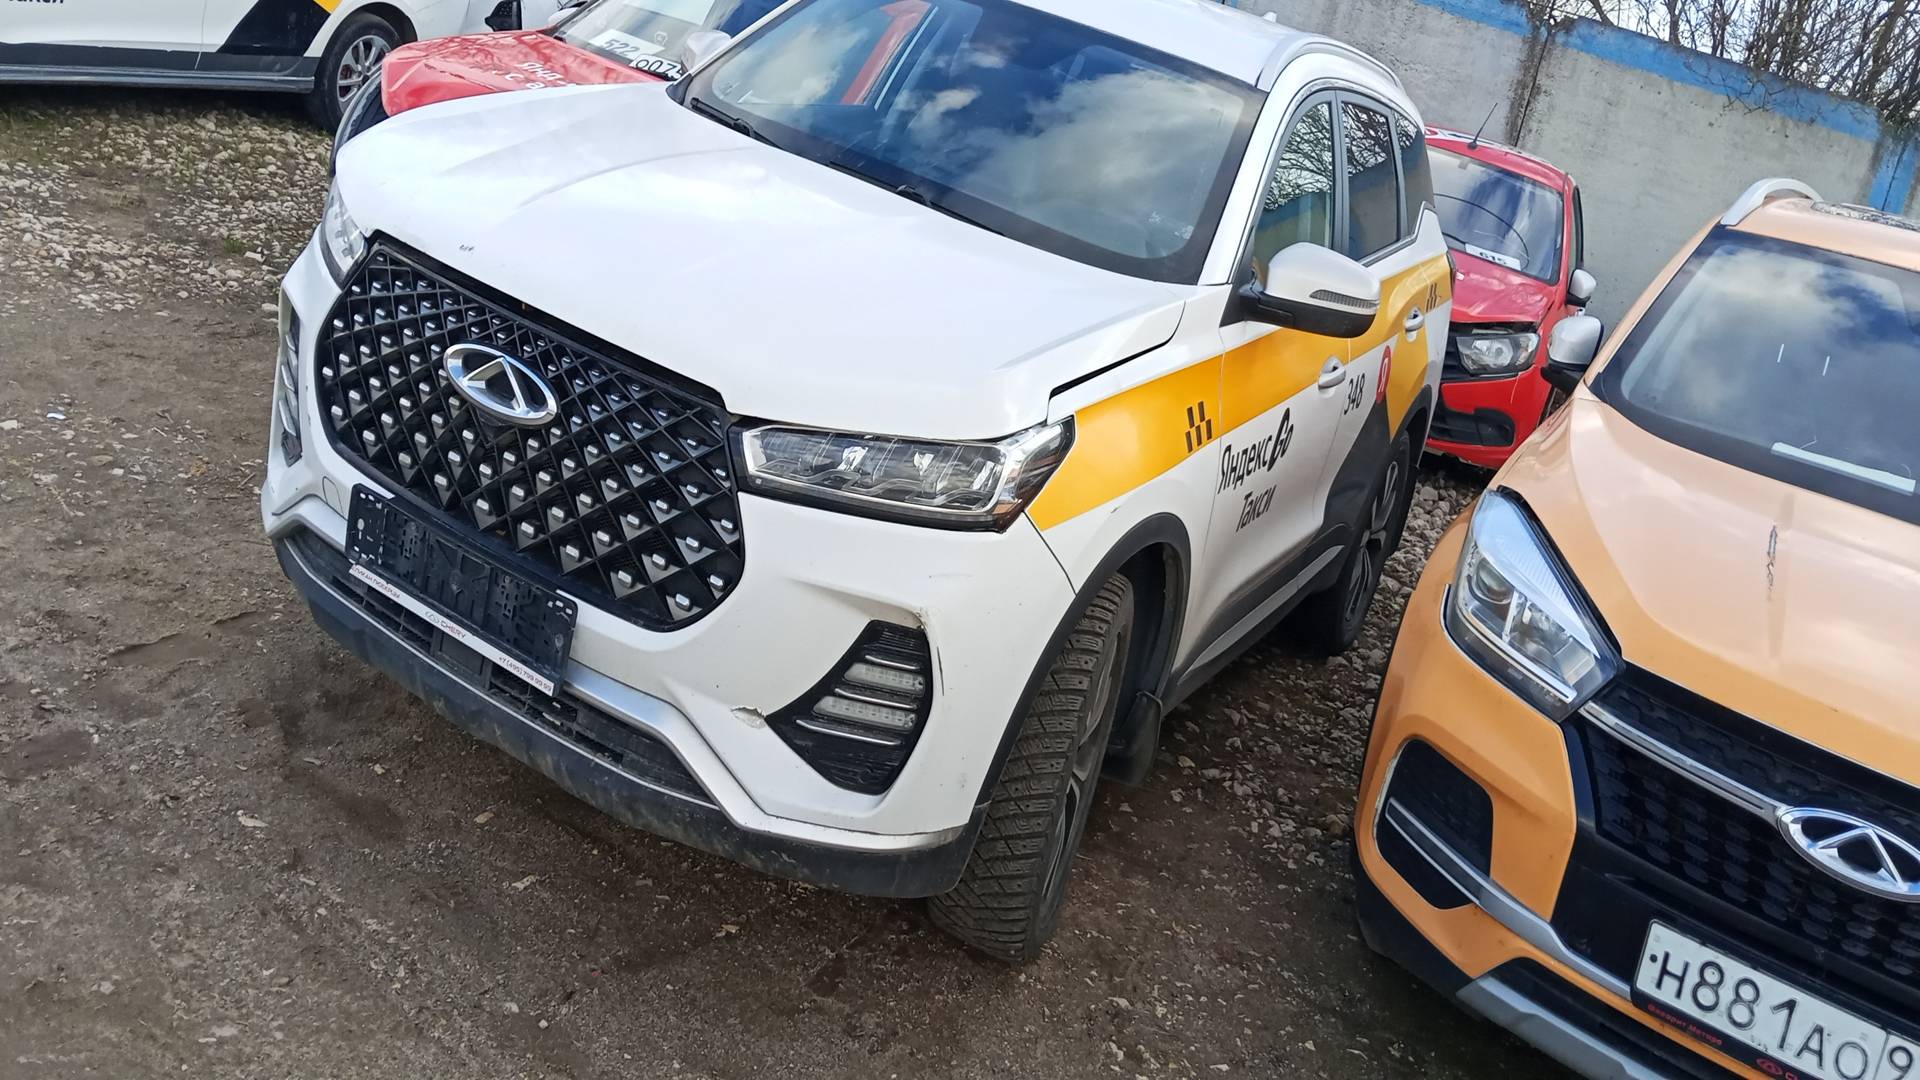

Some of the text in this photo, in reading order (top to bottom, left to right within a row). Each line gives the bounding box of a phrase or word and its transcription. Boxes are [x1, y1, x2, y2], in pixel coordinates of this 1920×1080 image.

[1343, 372, 1366, 416] 348
[1217, 406, 1295, 495] Яндекс Go
[1235, 484, 1278, 533] Такси
